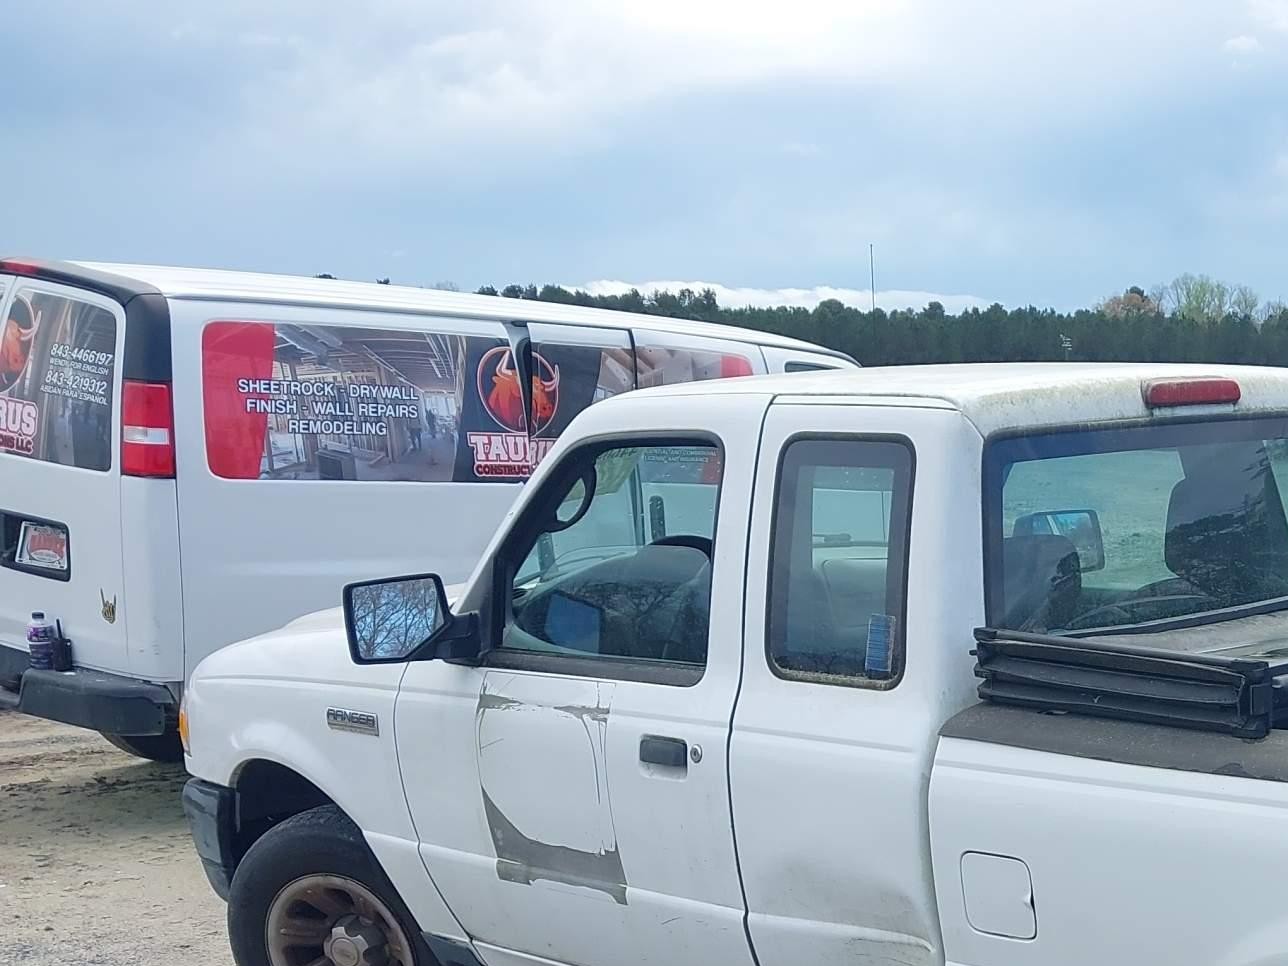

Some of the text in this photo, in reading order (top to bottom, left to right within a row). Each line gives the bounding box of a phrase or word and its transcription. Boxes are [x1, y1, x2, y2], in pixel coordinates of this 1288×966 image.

[51, 343, 113, 365] 843-4466197
[70, 361, 82, 370] FOR
[82, 363, 109, 375] ENGLISH
[45, 370, 107, 394] 843-4219312
[238, 379, 335, 396] SHEETROCK
[350, 384, 419, 400] DRYWALL
[62, 389, 78, 398] PARA
[246, 399, 297, 414] FINISH
[313, 401, 353, 416] WALL
[359, 403, 418, 418] REPAIRS
[288, 420, 387, 435] REMODELING
[16, 437, 33, 453] LLC
[327, 708, 376, 727] RANGER
